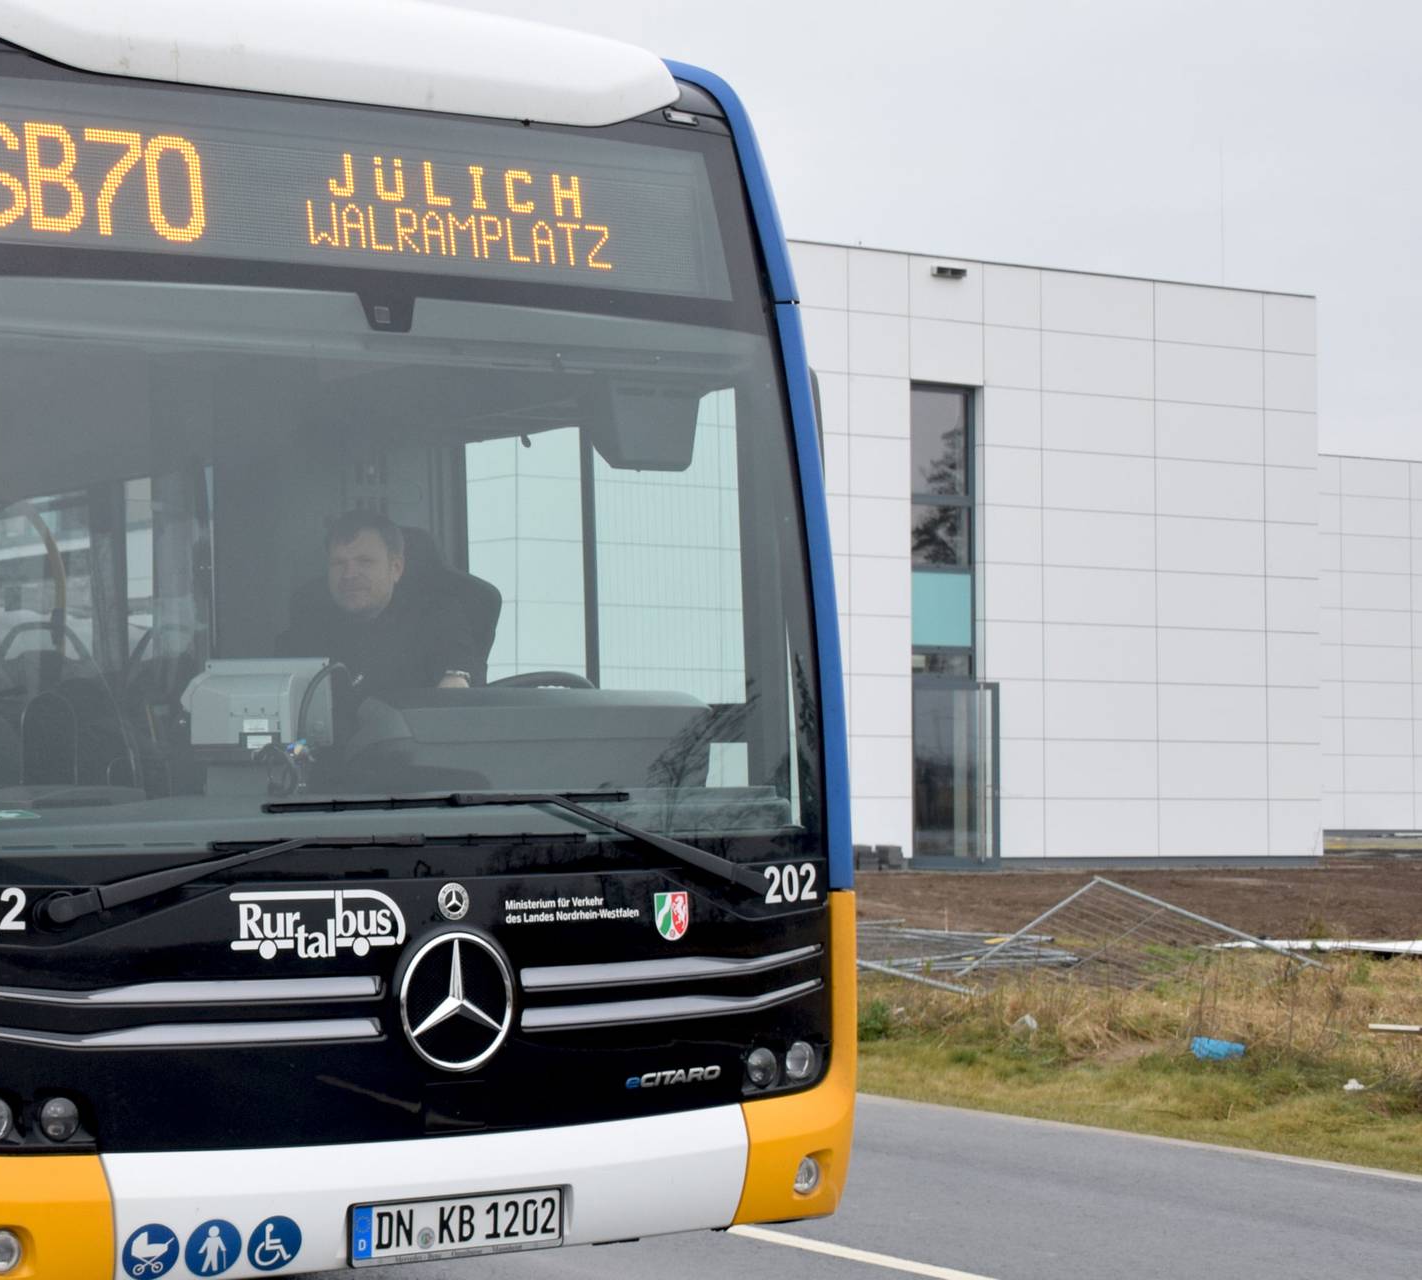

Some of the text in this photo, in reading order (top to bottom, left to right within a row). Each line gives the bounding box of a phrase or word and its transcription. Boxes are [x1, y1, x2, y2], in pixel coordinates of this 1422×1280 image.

[328, 153, 582, 218] JÜLICH
[306, 199, 612, 270] WALRAMPLATZ
[505, 895, 604, 911] Ministerium für Verkehr
[764, 862, 818, 904] 202
[505, 907, 641, 925] des Landes Nordrhein-Westfalen
[625, 1064, 721, 1089] eCITARO
[357, 1196, 556, 1251] D DN KB 1202
